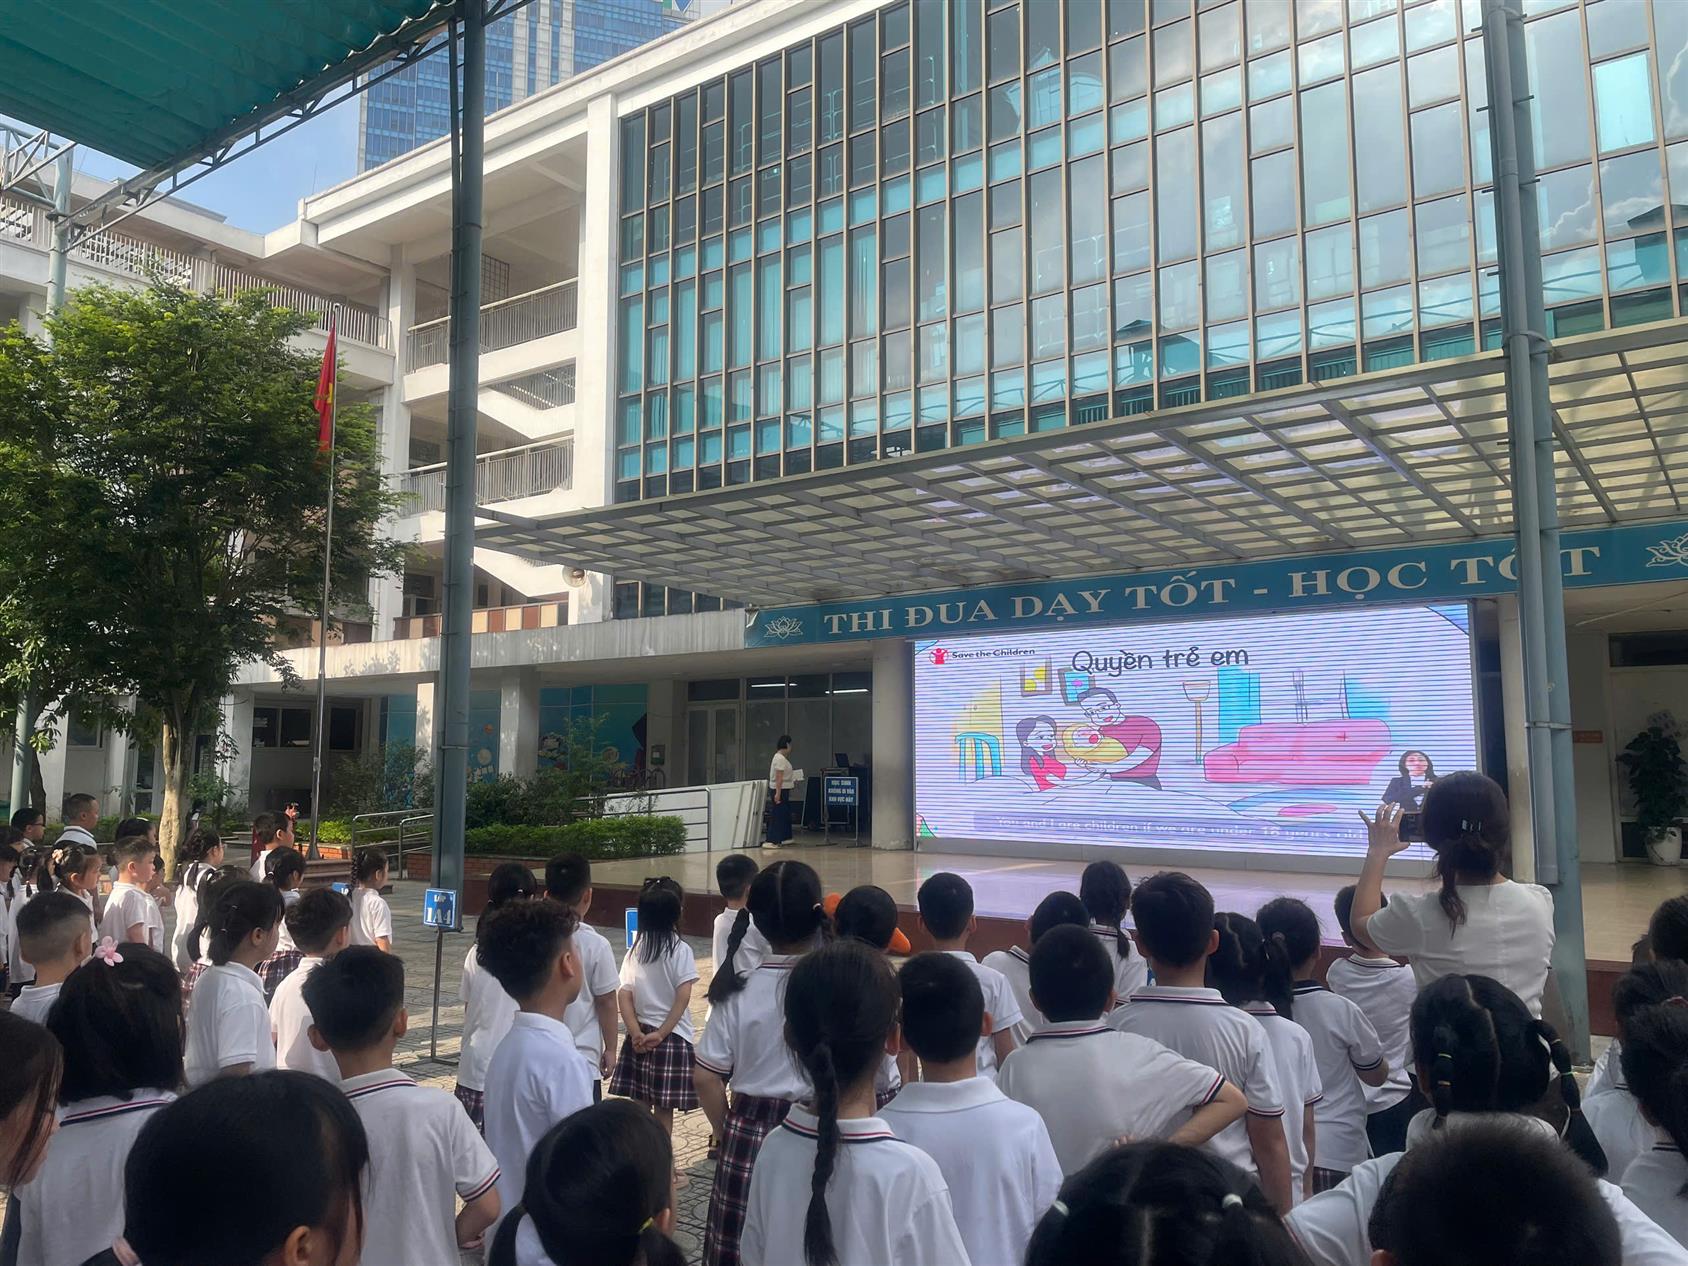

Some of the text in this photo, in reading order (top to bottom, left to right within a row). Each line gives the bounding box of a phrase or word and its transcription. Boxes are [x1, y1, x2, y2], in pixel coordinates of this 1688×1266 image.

[824, 609, 893, 634] THI
[904, 599, 998, 628] ĐUA
[1010, 589, 1112, 622] DẠY
[1124, 570, 1236, 610] TỐT
[1288, 561, 1428, 600] HỌC
[952, 648, 1036, 659] Save the Children
[1072, 646, 1249, 678] Quyền trẻ em
[996, 816, 1018, 827] You
[1084, 820, 1138, 832] children
